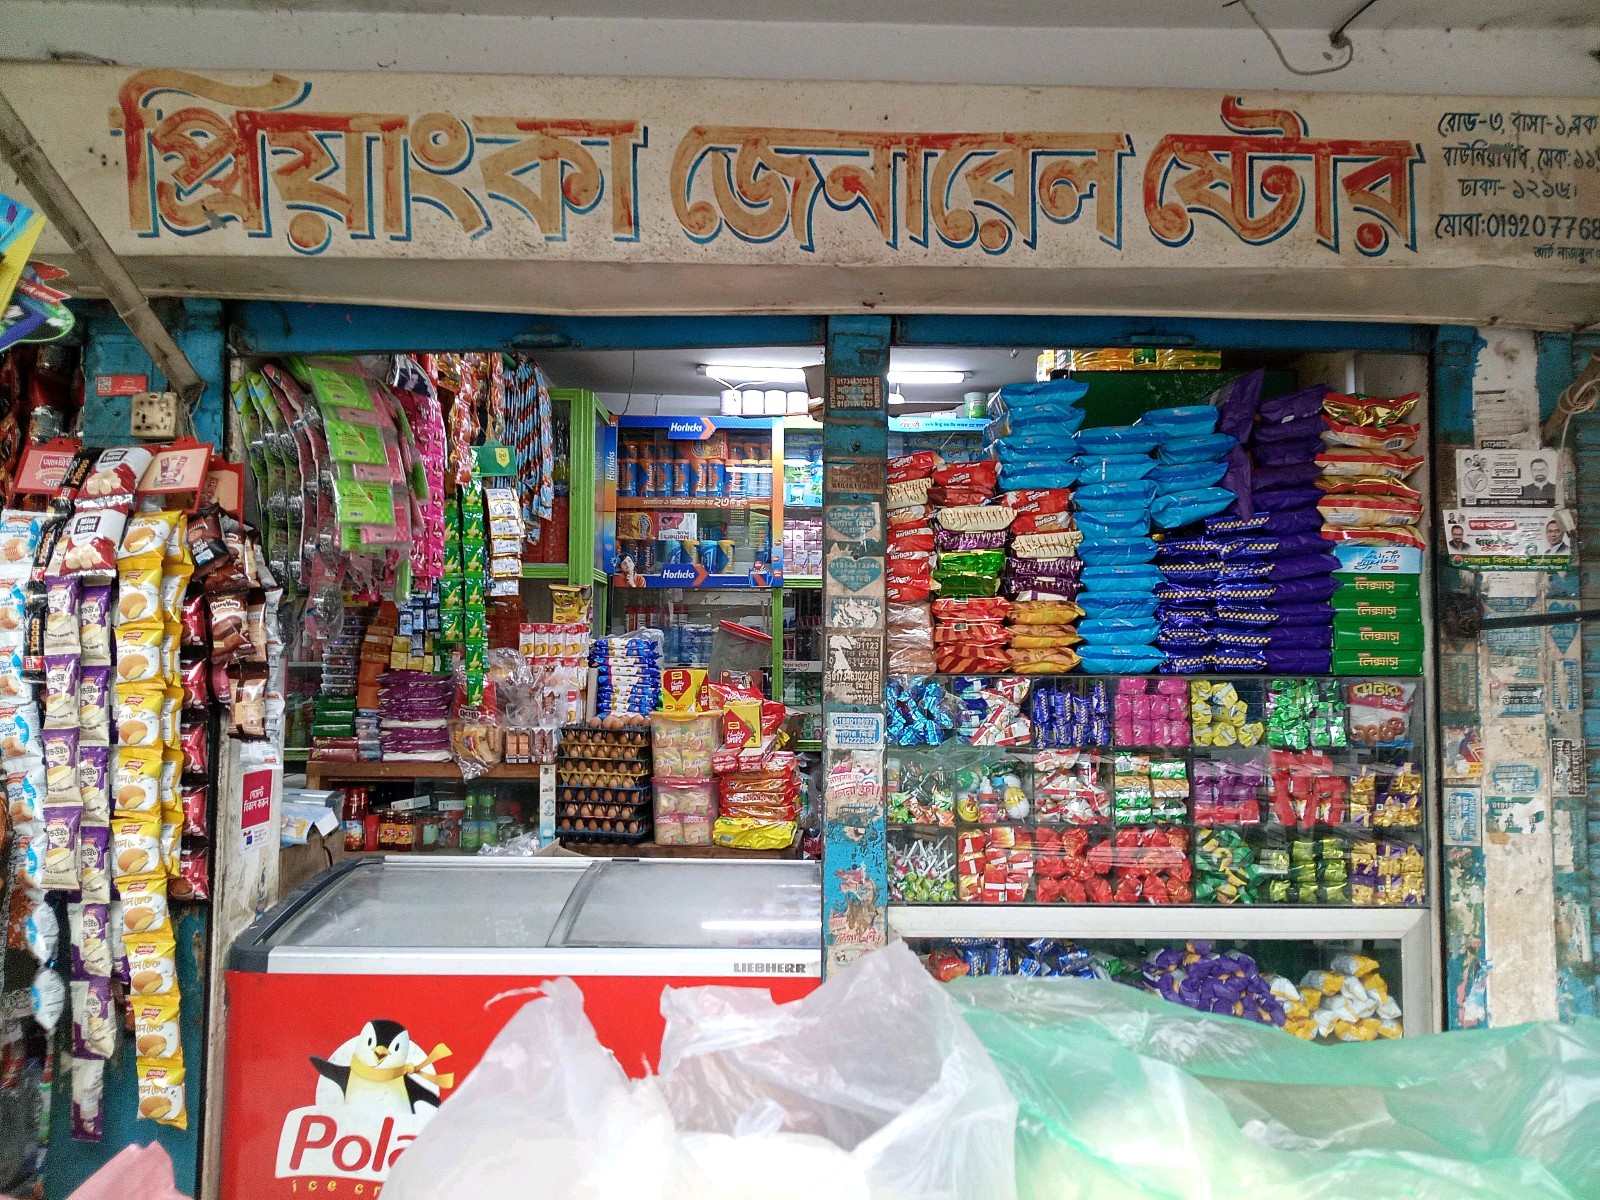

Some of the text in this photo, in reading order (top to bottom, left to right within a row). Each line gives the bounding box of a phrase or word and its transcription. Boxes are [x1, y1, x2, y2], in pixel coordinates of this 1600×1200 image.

[670, 125, 1135, 252] জেনারেল
[670, 422, 703, 433] Horlicks
[607, 451, 615, 481] Horlicks
[662, 564, 695, 579] Horlicks
[733, 962, 807, 973] LIEBHERR
[289, 1114, 419, 1173] Pola
[292, 1179, 381, 1197] ice cr
